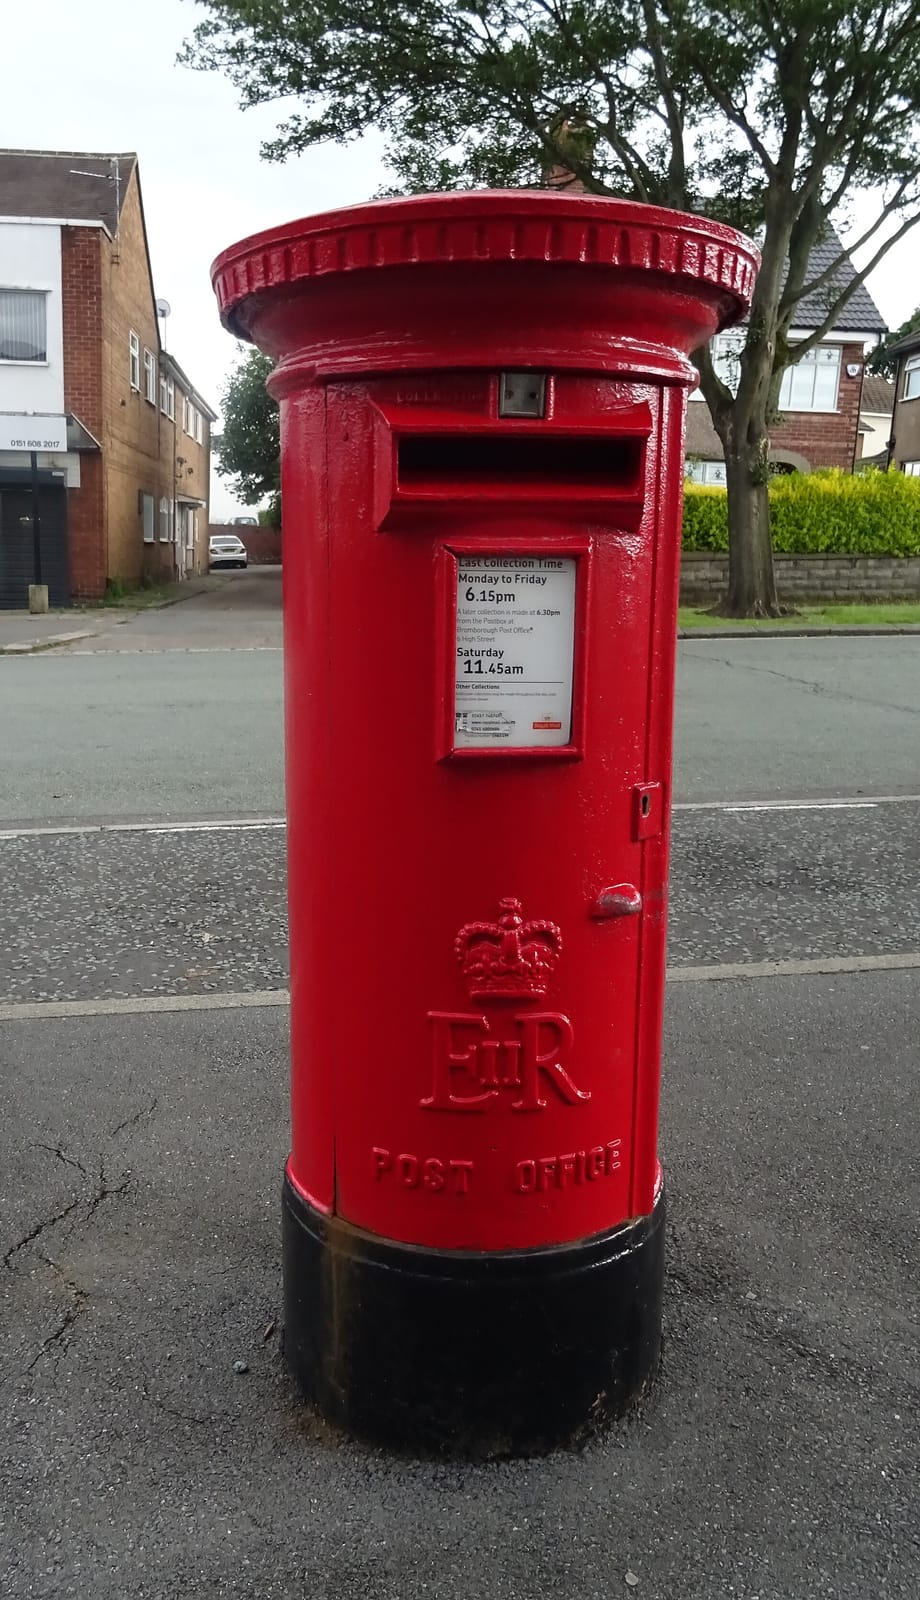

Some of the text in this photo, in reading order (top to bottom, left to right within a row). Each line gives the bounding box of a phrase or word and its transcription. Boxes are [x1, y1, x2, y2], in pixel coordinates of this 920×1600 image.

[459, 559, 563, 568] Last Collection Time
[458, 574, 547, 585] Monday to Friday
[465, 587, 515, 604] 6.15pm
[457, 648, 504, 659] Saturday
[464, 660, 524, 674] 11.45am
[372, 1138, 622, 1194] POST OFFICE
